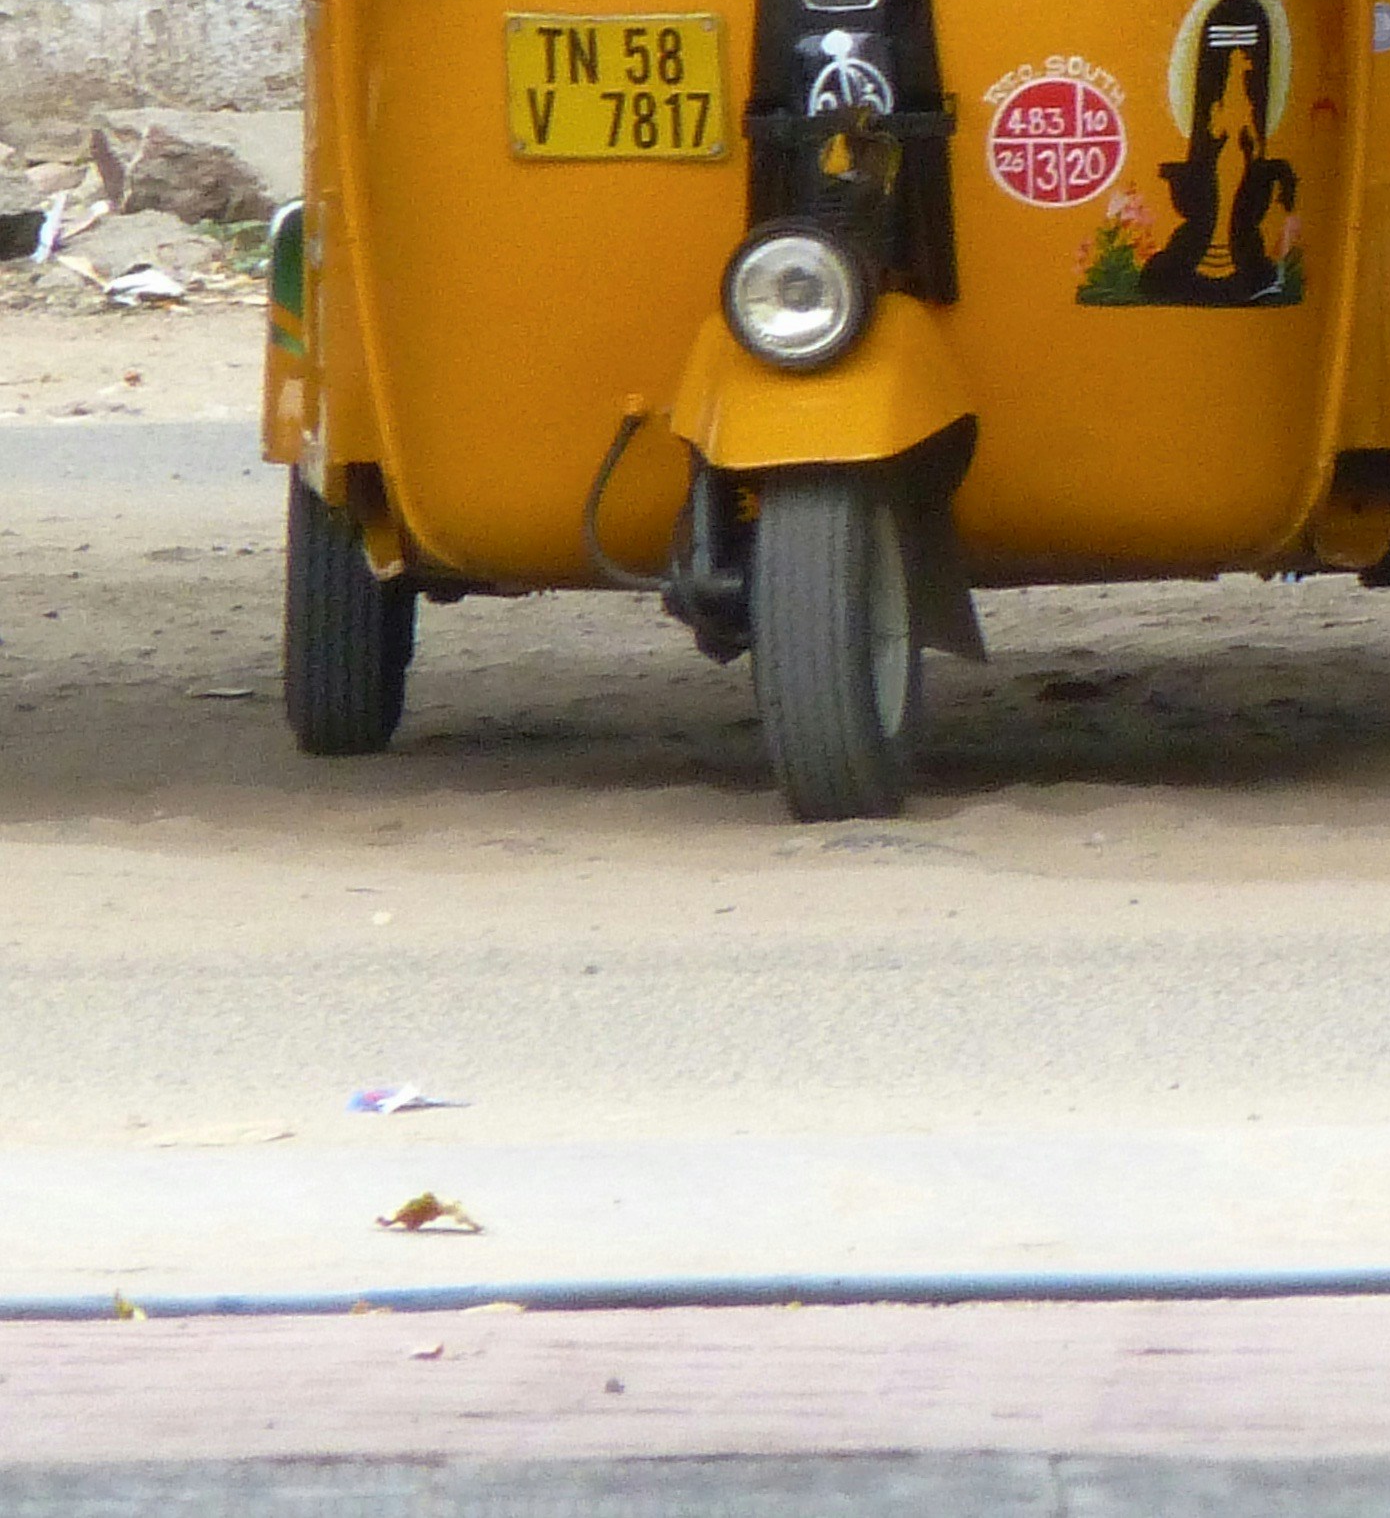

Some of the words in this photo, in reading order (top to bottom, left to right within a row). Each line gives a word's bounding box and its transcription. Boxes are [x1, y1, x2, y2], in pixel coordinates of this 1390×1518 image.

[538, 26, 599, 84] TN
[623, 27, 684, 84] 58
[526, 87, 555, 145] V
[600, 91, 711, 149] 7817
[1007, 107, 1065, 135] 483
[1036, 149, 1059, 191] 3
[1066, 147, 1107, 185] 20
